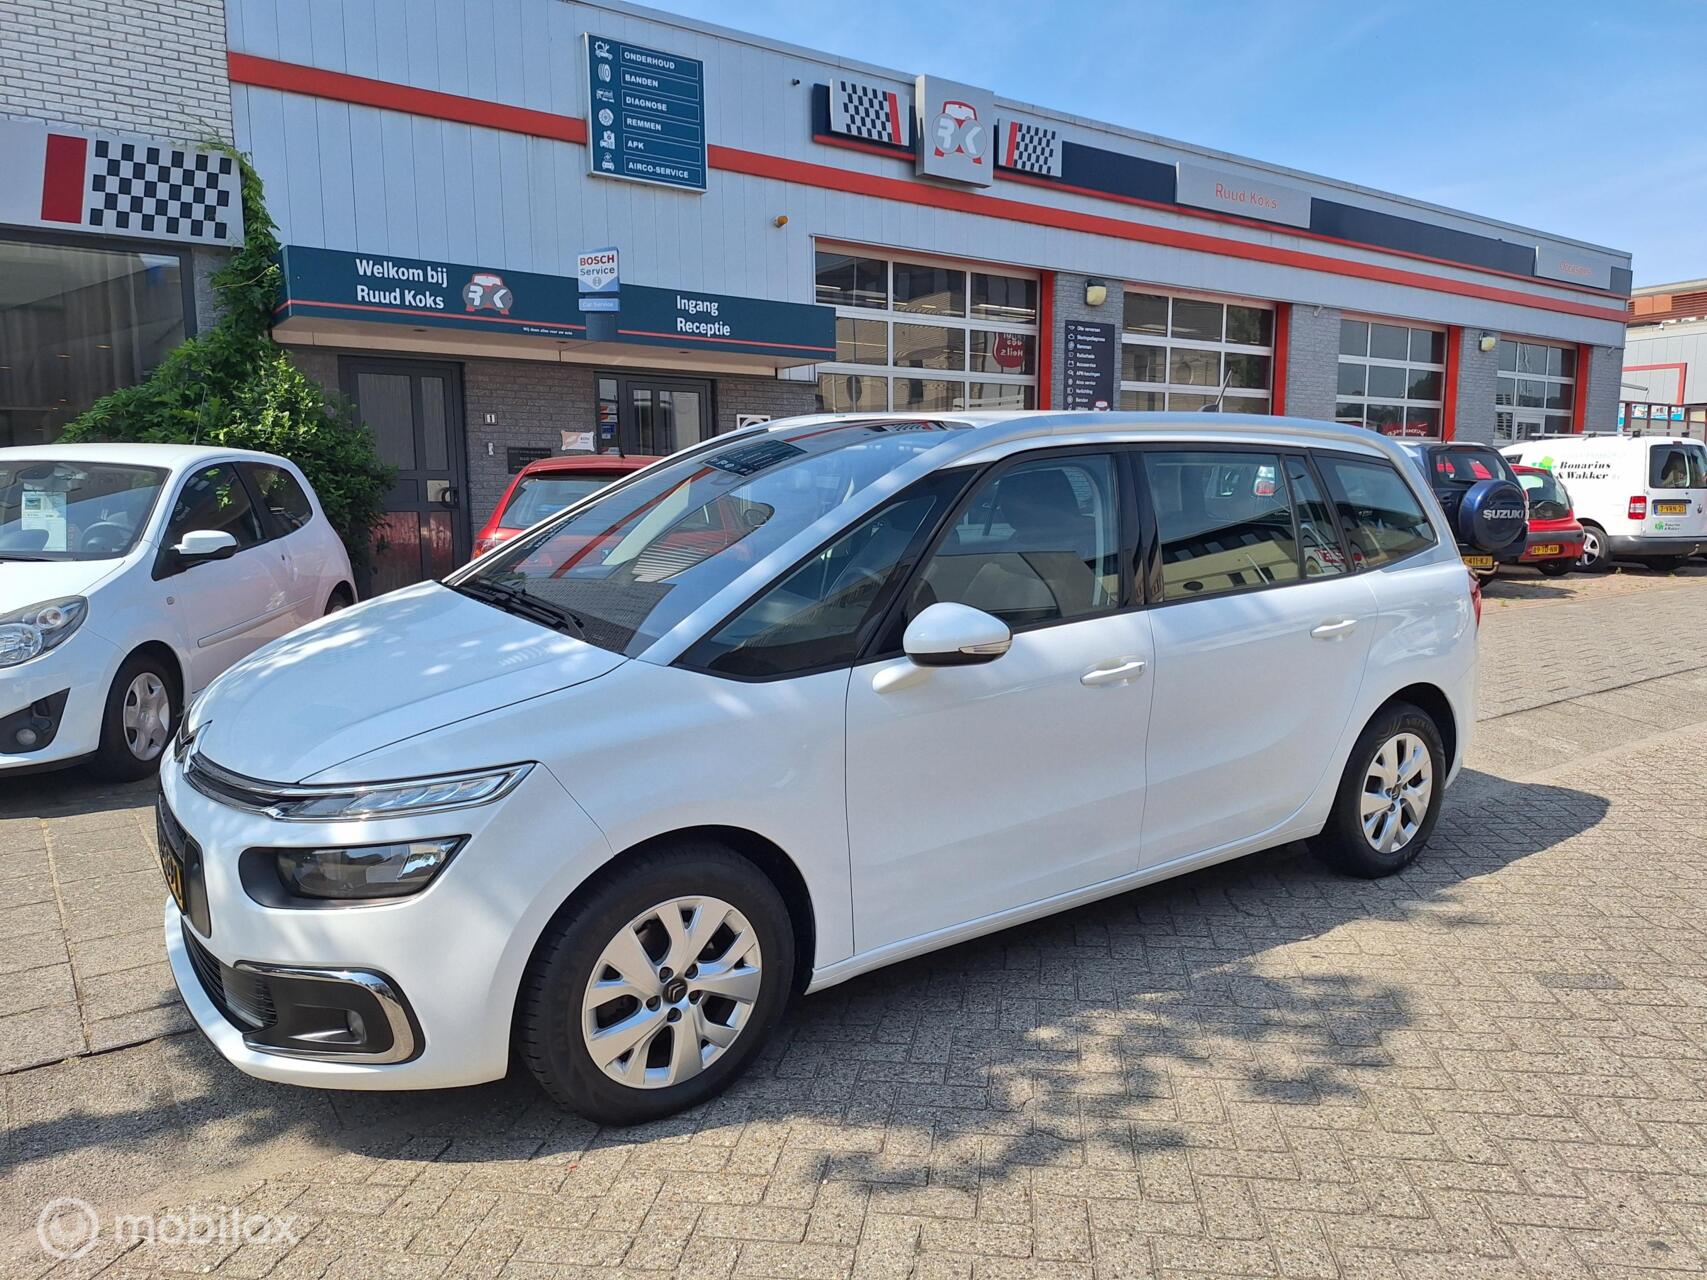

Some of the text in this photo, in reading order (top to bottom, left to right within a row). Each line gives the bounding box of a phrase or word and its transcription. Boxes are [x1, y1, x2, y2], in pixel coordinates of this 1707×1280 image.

[624, 51, 675, 70] ONDERHOUD
[625, 74, 658, 88] BANDEN
[625, 96, 667, 111] DIAGNOSE
[626, 118, 662, 131] REMMEN
[627, 140, 645, 150] APK
[628, 161, 689, 179] AIRCO-SERVICE
[1215, 182, 1278, 210] Ruud Koks
[580, 254, 615, 266] BOSCH
[355, 258, 448, 288] Welkom bij
[580, 266, 615, 276] Service
[356, 284, 445, 309] Ruud Koks
[676, 295, 719, 317] Ingang
[676, 317, 731, 338] Receptie
[1567, 471, 1609, 480] Wakker
[1482, 509, 1525, 521] SUZUKI
